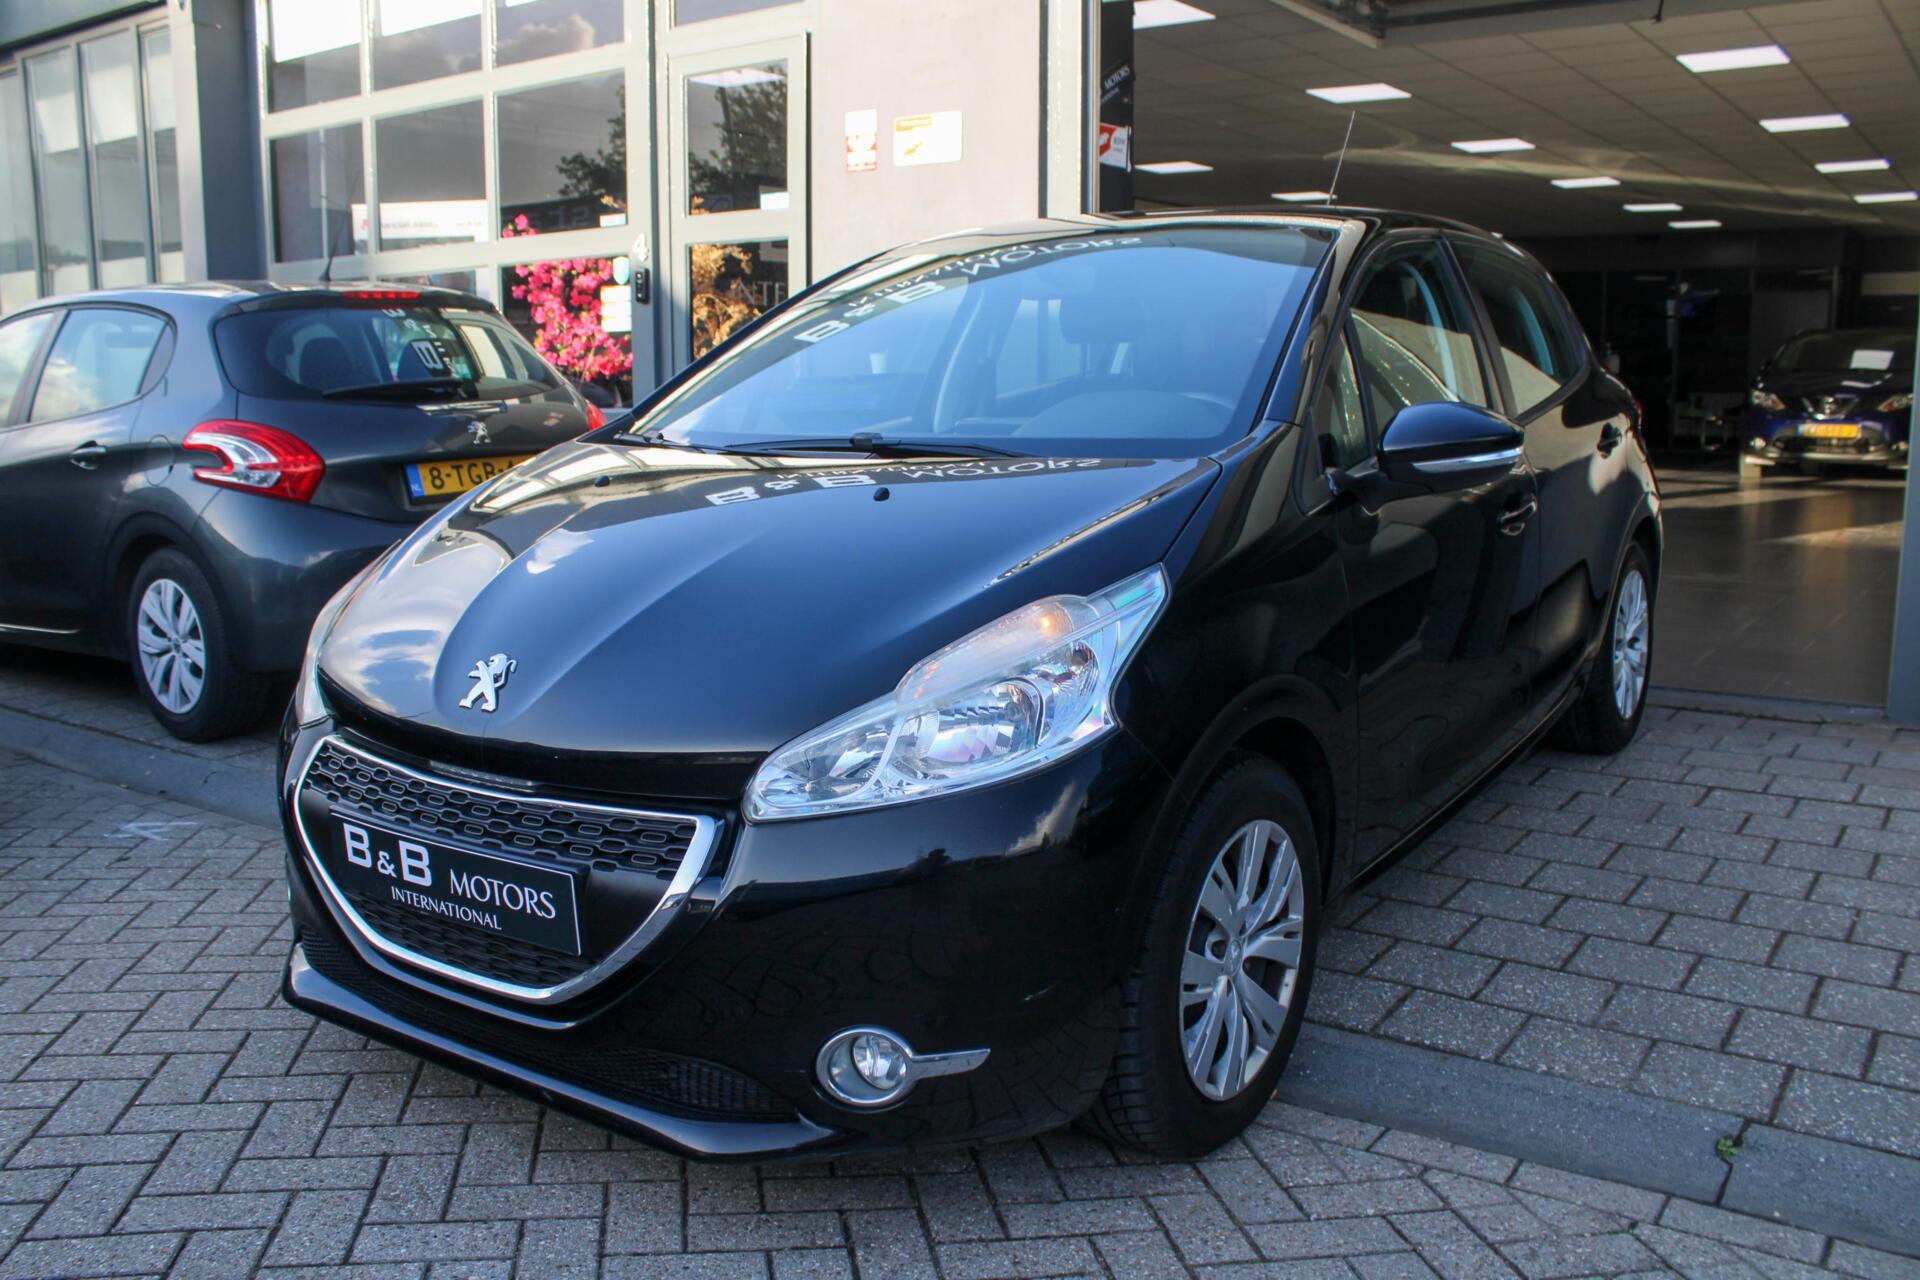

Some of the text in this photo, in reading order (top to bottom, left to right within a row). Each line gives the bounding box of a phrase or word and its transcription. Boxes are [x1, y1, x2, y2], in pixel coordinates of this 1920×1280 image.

[343, 822, 556, 919] B & B MOTORS
[391, 886, 502, 931] INTERNATIONAL
